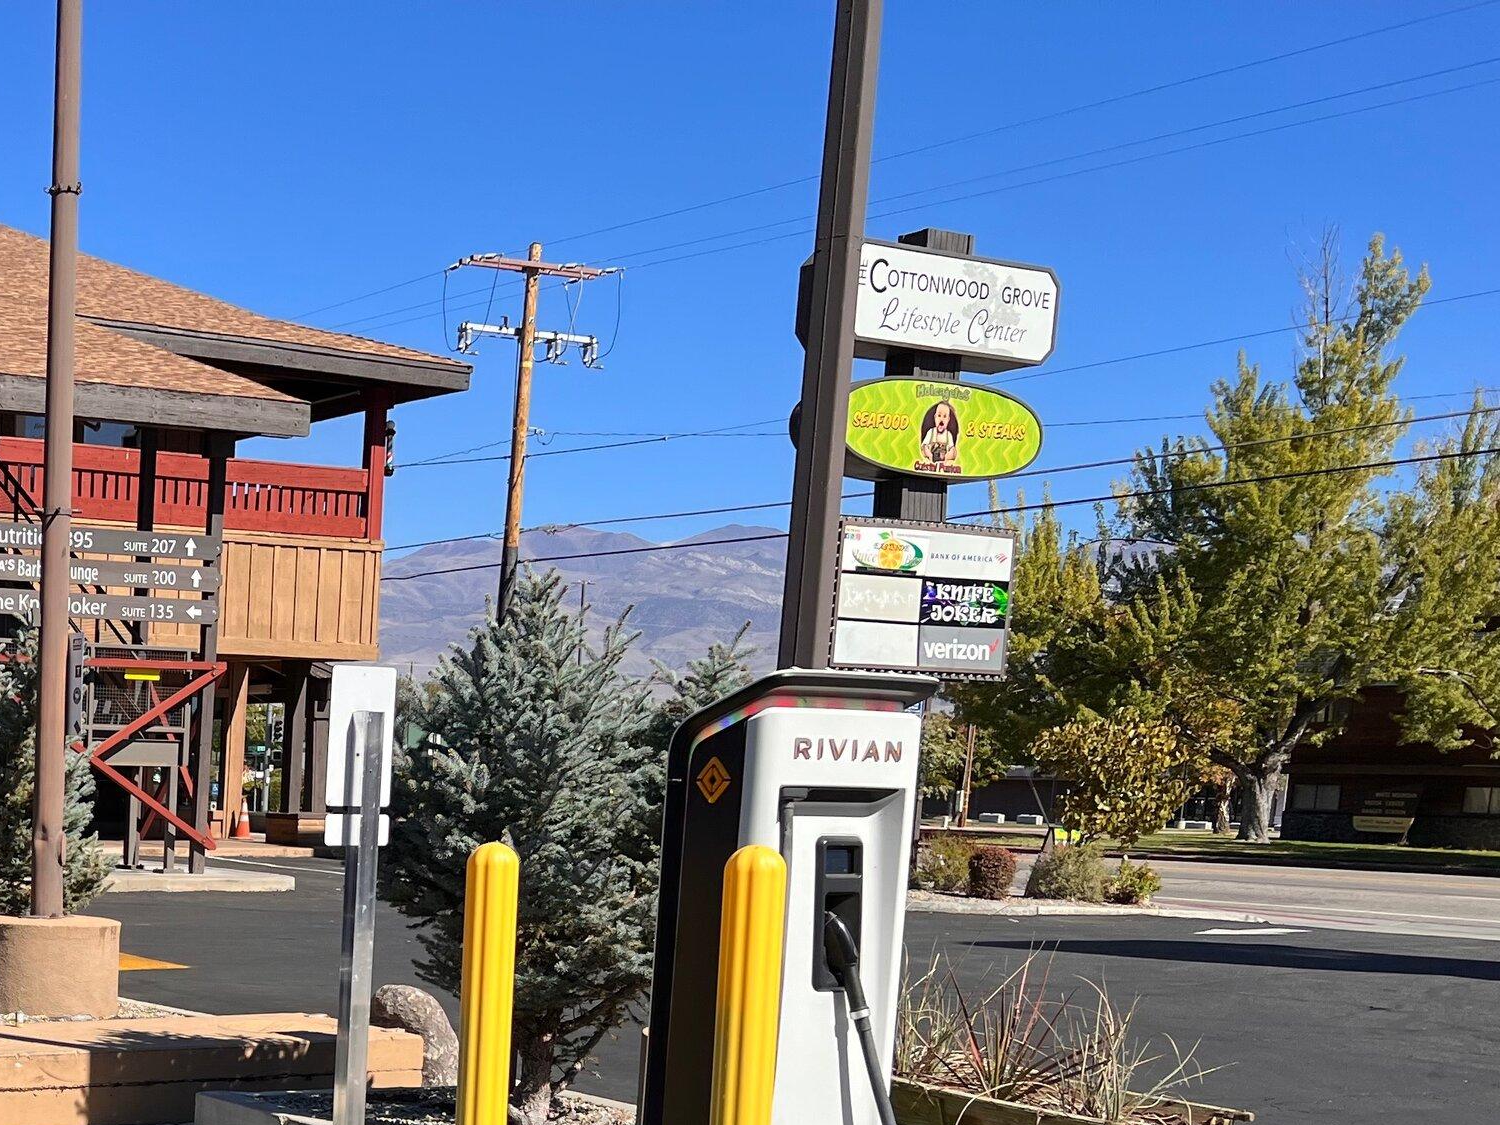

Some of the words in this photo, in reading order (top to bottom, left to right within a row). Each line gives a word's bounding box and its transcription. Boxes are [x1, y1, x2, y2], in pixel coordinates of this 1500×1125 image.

[1001, 285, 1051, 310] GROVE
[878, 296, 961, 337] Lifestyle
[967, 308, 1028, 345] Center
[852, 410, 911, 431] SEAFOOD
[966, 421, 978, 438] &
[979, 422, 1028, 441] STEAKS
[123, 540, 148, 553] SUITE
[151, 538, 177, 554] 207
[930, 552, 950, 560] BANK
[951, 553, 960, 561] OF
[962, 554, 993, 563] AMERICA
[17, 561, 41, 578] Barb
[70, 565, 99, 584] unge
[123, 572, 148, 584] SUITE
[935, 582, 995, 603] KNIFE
[121, 606, 146, 618] SUITE
[149, 603, 174, 619] 135
[930, 604, 998, 624] JOKER
[923, 638, 990, 661] verizon
[793, 737, 903, 762] RIVIAN
